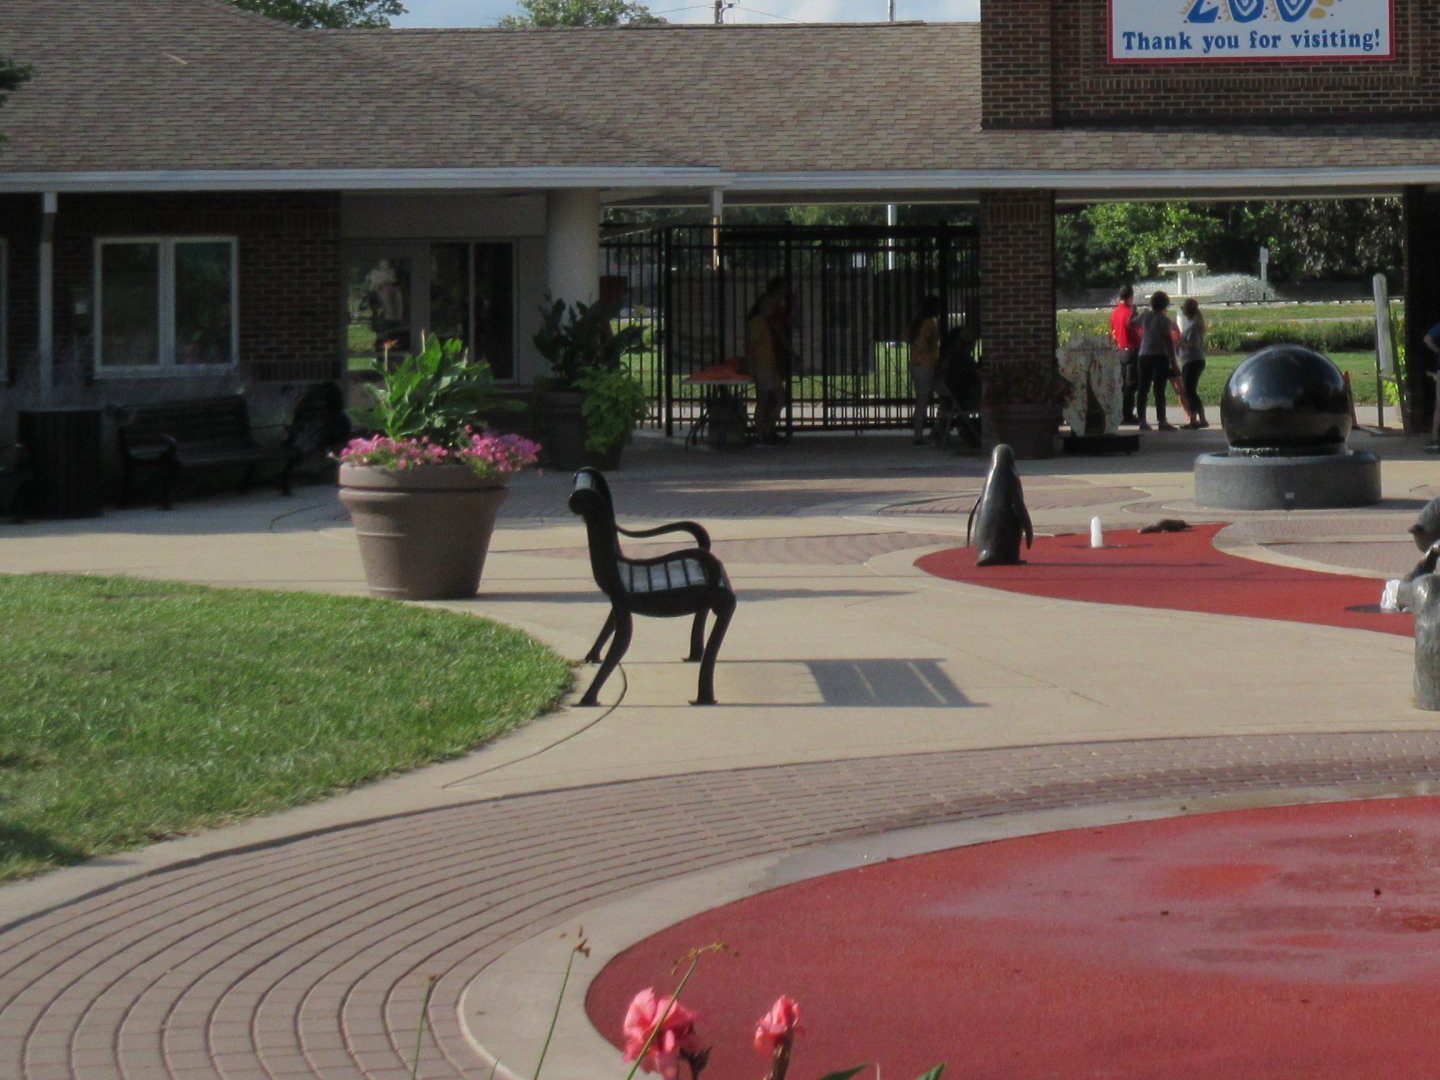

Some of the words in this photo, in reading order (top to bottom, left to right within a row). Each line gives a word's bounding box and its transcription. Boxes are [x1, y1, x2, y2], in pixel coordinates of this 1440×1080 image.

[1122, 32, 1193, 50] Thank
[1203, 35, 1239, 53] you
[1249, 31, 1282, 49] for
[1291, 29, 1381, 51] visiting!
